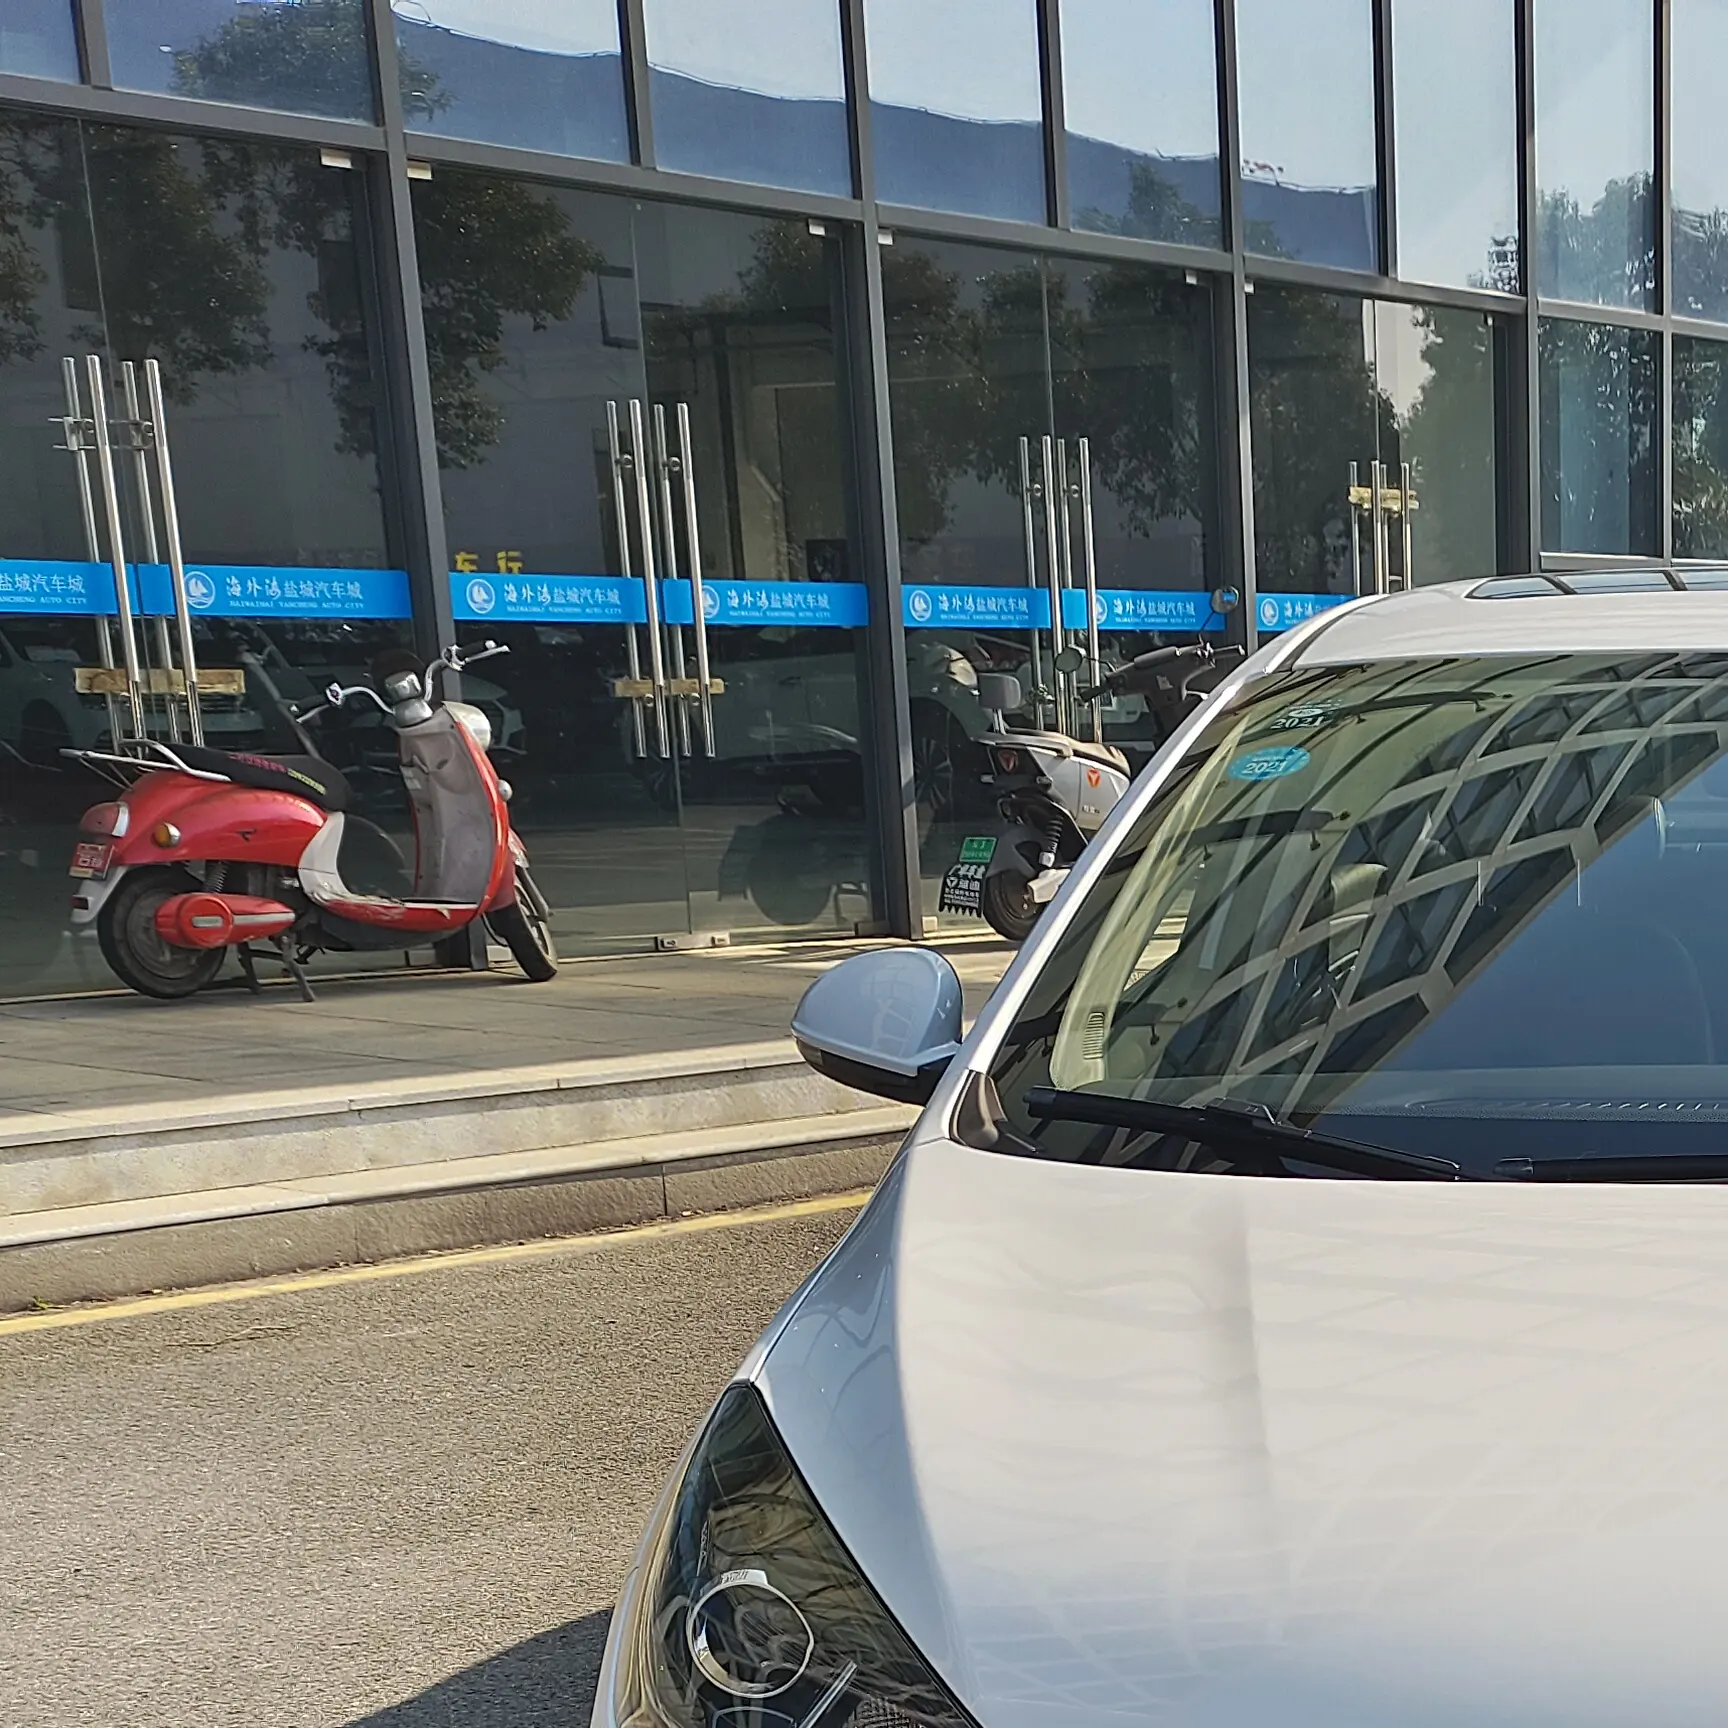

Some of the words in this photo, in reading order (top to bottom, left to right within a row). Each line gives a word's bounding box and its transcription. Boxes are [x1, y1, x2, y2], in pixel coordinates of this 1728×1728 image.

[66, 597, 87, 605] CITY
[1270, 716, 1325, 729] 2021
[1241, 761, 1288, 774] 2021
